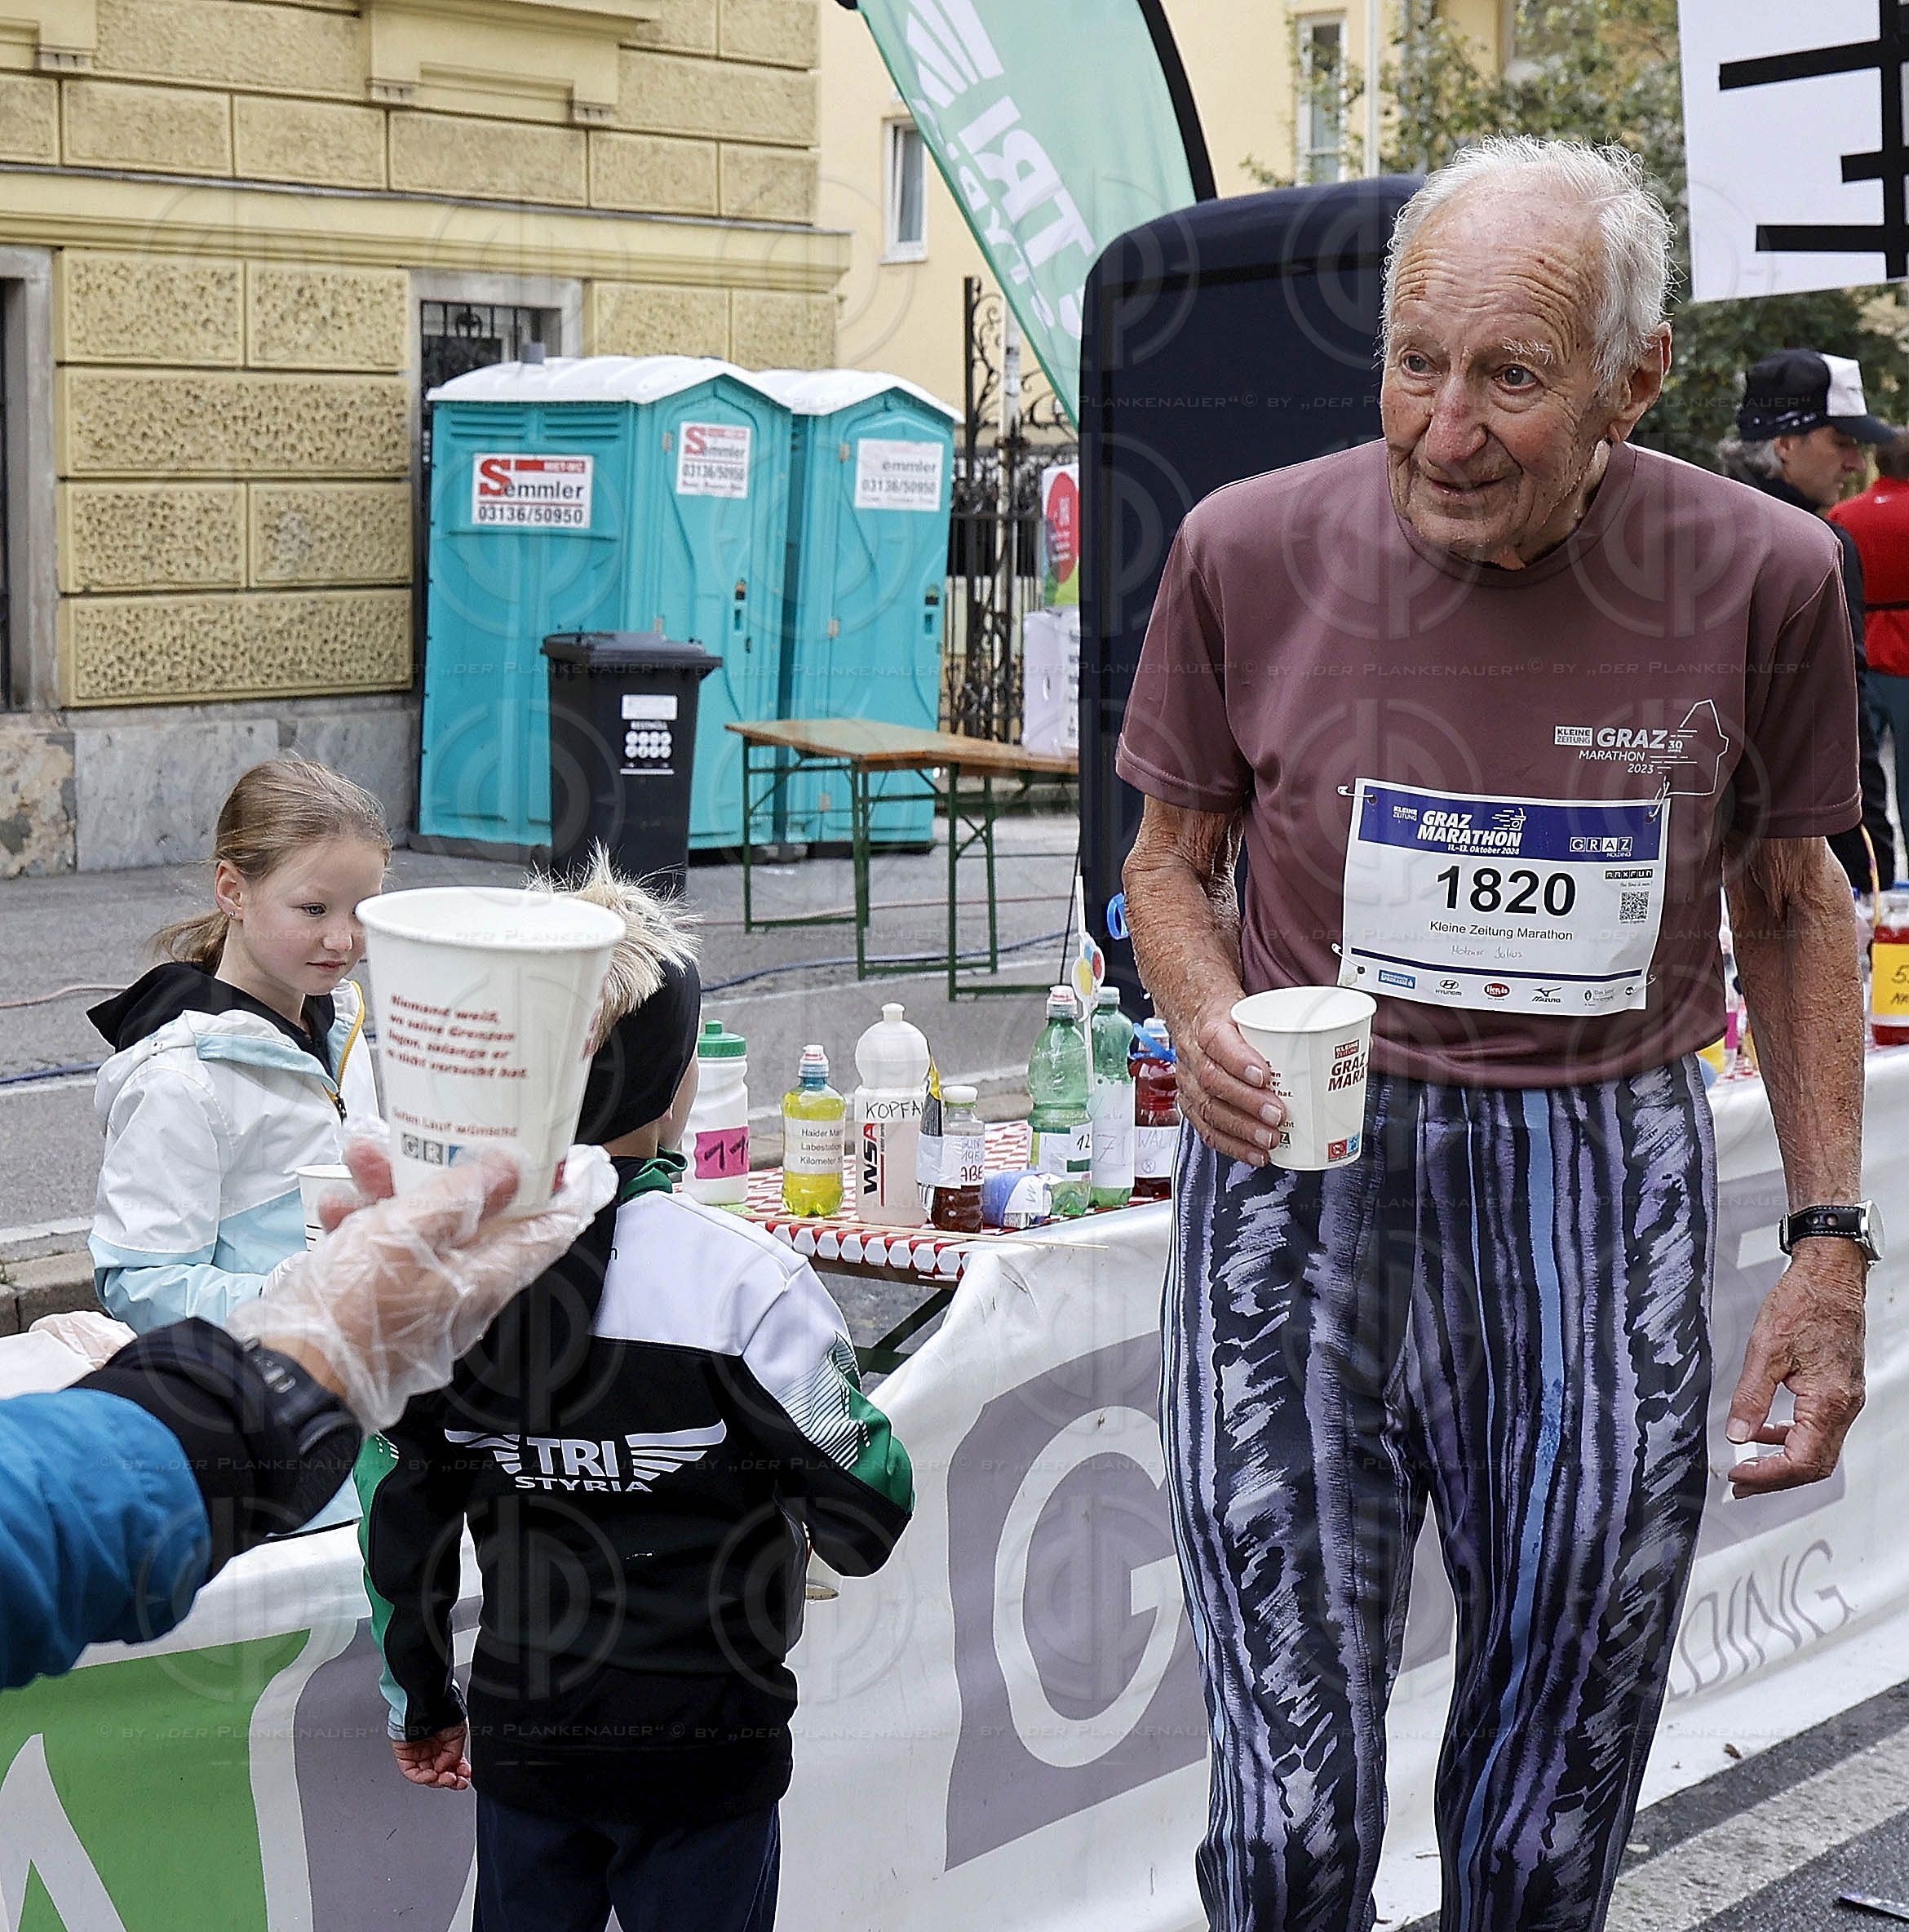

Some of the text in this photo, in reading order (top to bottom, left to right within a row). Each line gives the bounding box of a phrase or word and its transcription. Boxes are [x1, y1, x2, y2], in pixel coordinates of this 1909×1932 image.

[684, 426, 746, 459] Semmler
[479, 459, 584, 499] Semmler
[478, 506, 583, 524] 03136/50950
[1556, 735, 1591, 744] ZEITUNG
[1557, 727, 1684, 749] KLEINE GRAZ 30
[1579, 750, 1645, 762] MARATHON
[1627, 764, 1654, 774] 2023
[1423, 810, 1473, 829] GRAZ
[1417, 824, 1523, 847] MARATHON
[1571, 839, 1630, 851] GRAZ
[1469, 845, 1500, 854] Oktober
[1501, 847, 1520, 855] 2024
[1437, 865, 1576, 916] 1820
[1429, 921, 1573, 940] Kleine Zeitung Marathon
[1327, 1066, 1365, 1092] MARA
[801, 1128, 827, 1137] Haider
[799, 1156, 836, 1165] Kilometer
[863, 1123, 878, 1194] WSA
[526, 1437, 619, 1478] TRI
[515, 1476, 653, 1492] STYRIA
